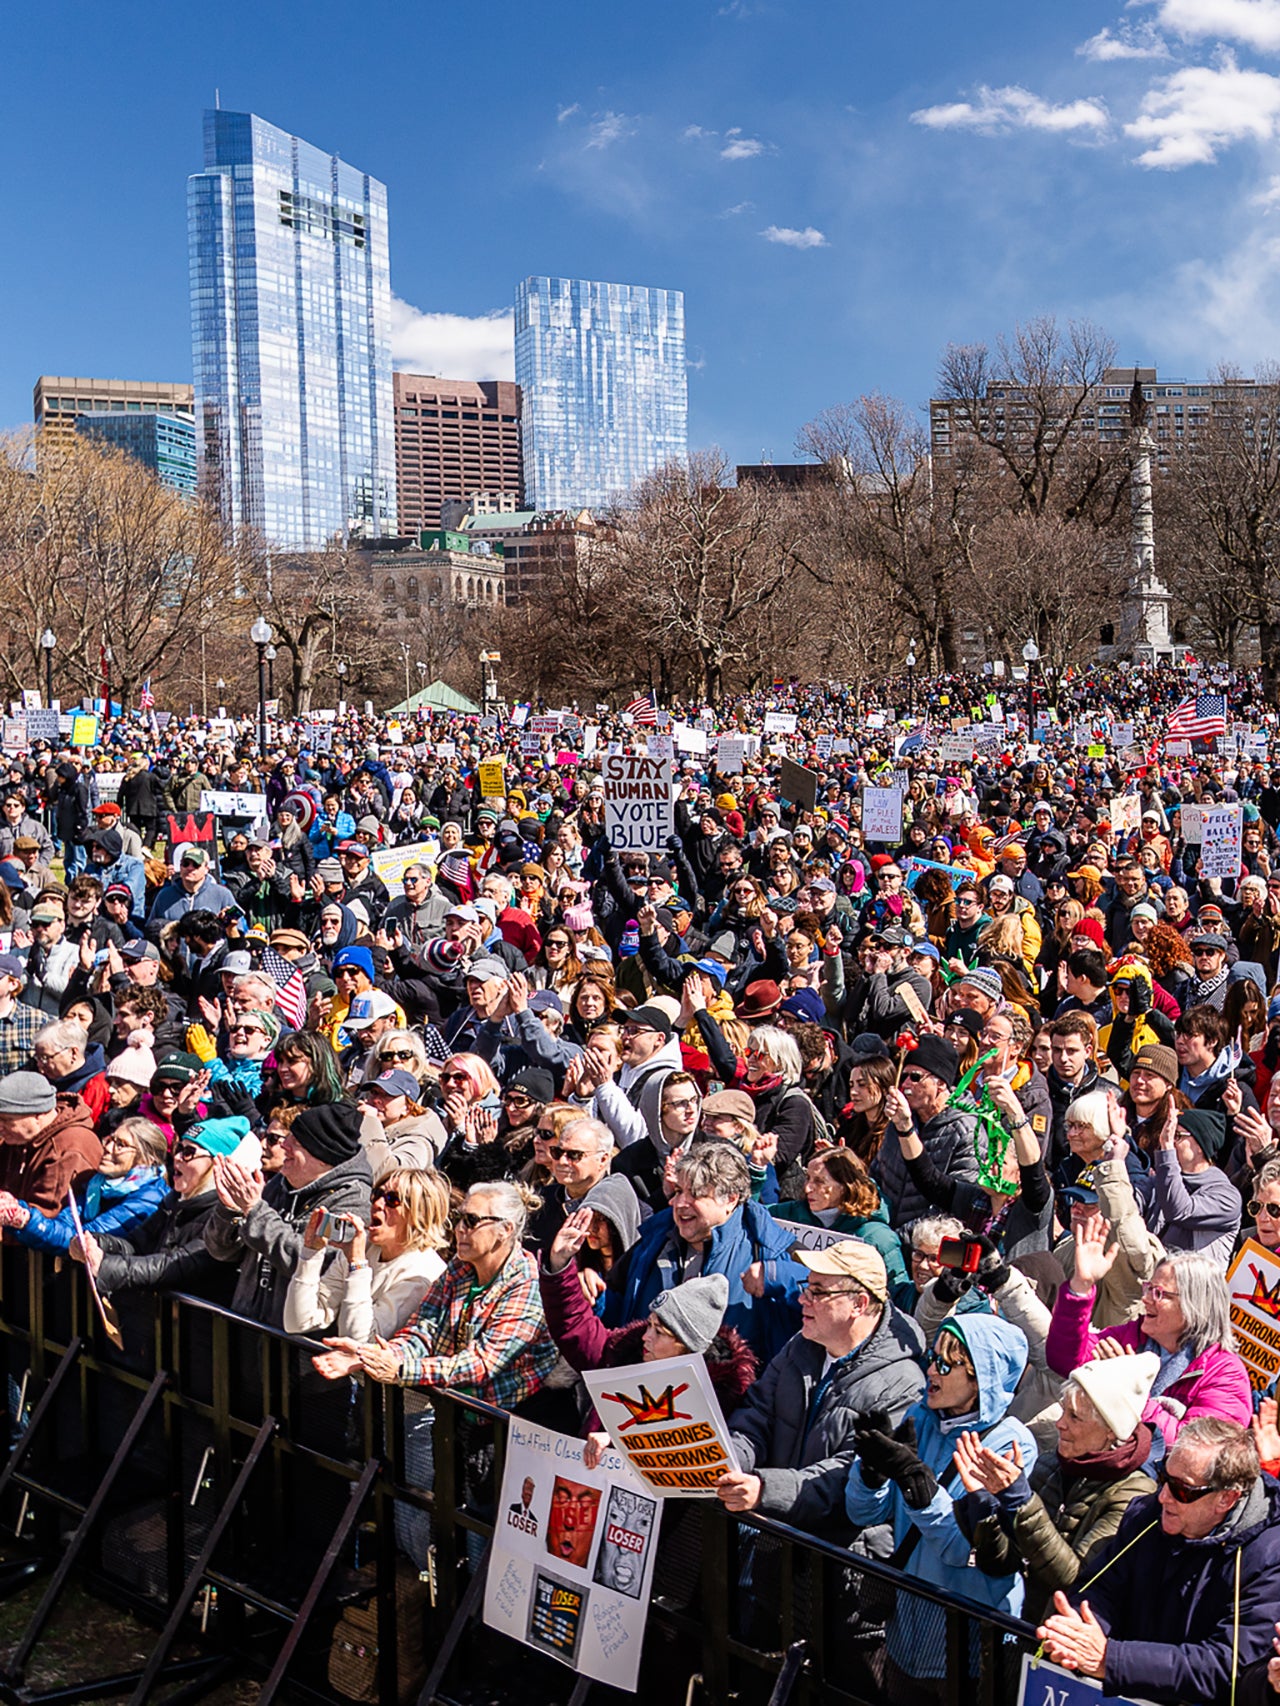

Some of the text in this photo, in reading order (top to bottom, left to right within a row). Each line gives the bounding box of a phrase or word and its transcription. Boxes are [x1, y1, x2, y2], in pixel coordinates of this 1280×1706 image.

[605, 755, 667, 780] STAY
[604, 782, 669, 800] HUMAN
[610, 802, 668, 822] VOTE
[1209, 815, 1233, 824] FREE
[610, 824, 668, 849] BLUE
[864, 824, 899, 835] LAWLESS
[1206, 826, 1241, 837] BALLS!
[622, 1422, 713, 1451] NO THRONES
[534, 1433, 550, 1452] First
[554, 1438, 582, 1461] Class
[599, 1453, 627, 1471] ose
[634, 1445, 722, 1468] NO CROWNS
[646, 1471, 672, 1487] NO
[506, 1510, 538, 1538] LOSER
[608, 1527, 644, 1552] LOSER
[551, 1589, 580, 1608] LOSER
